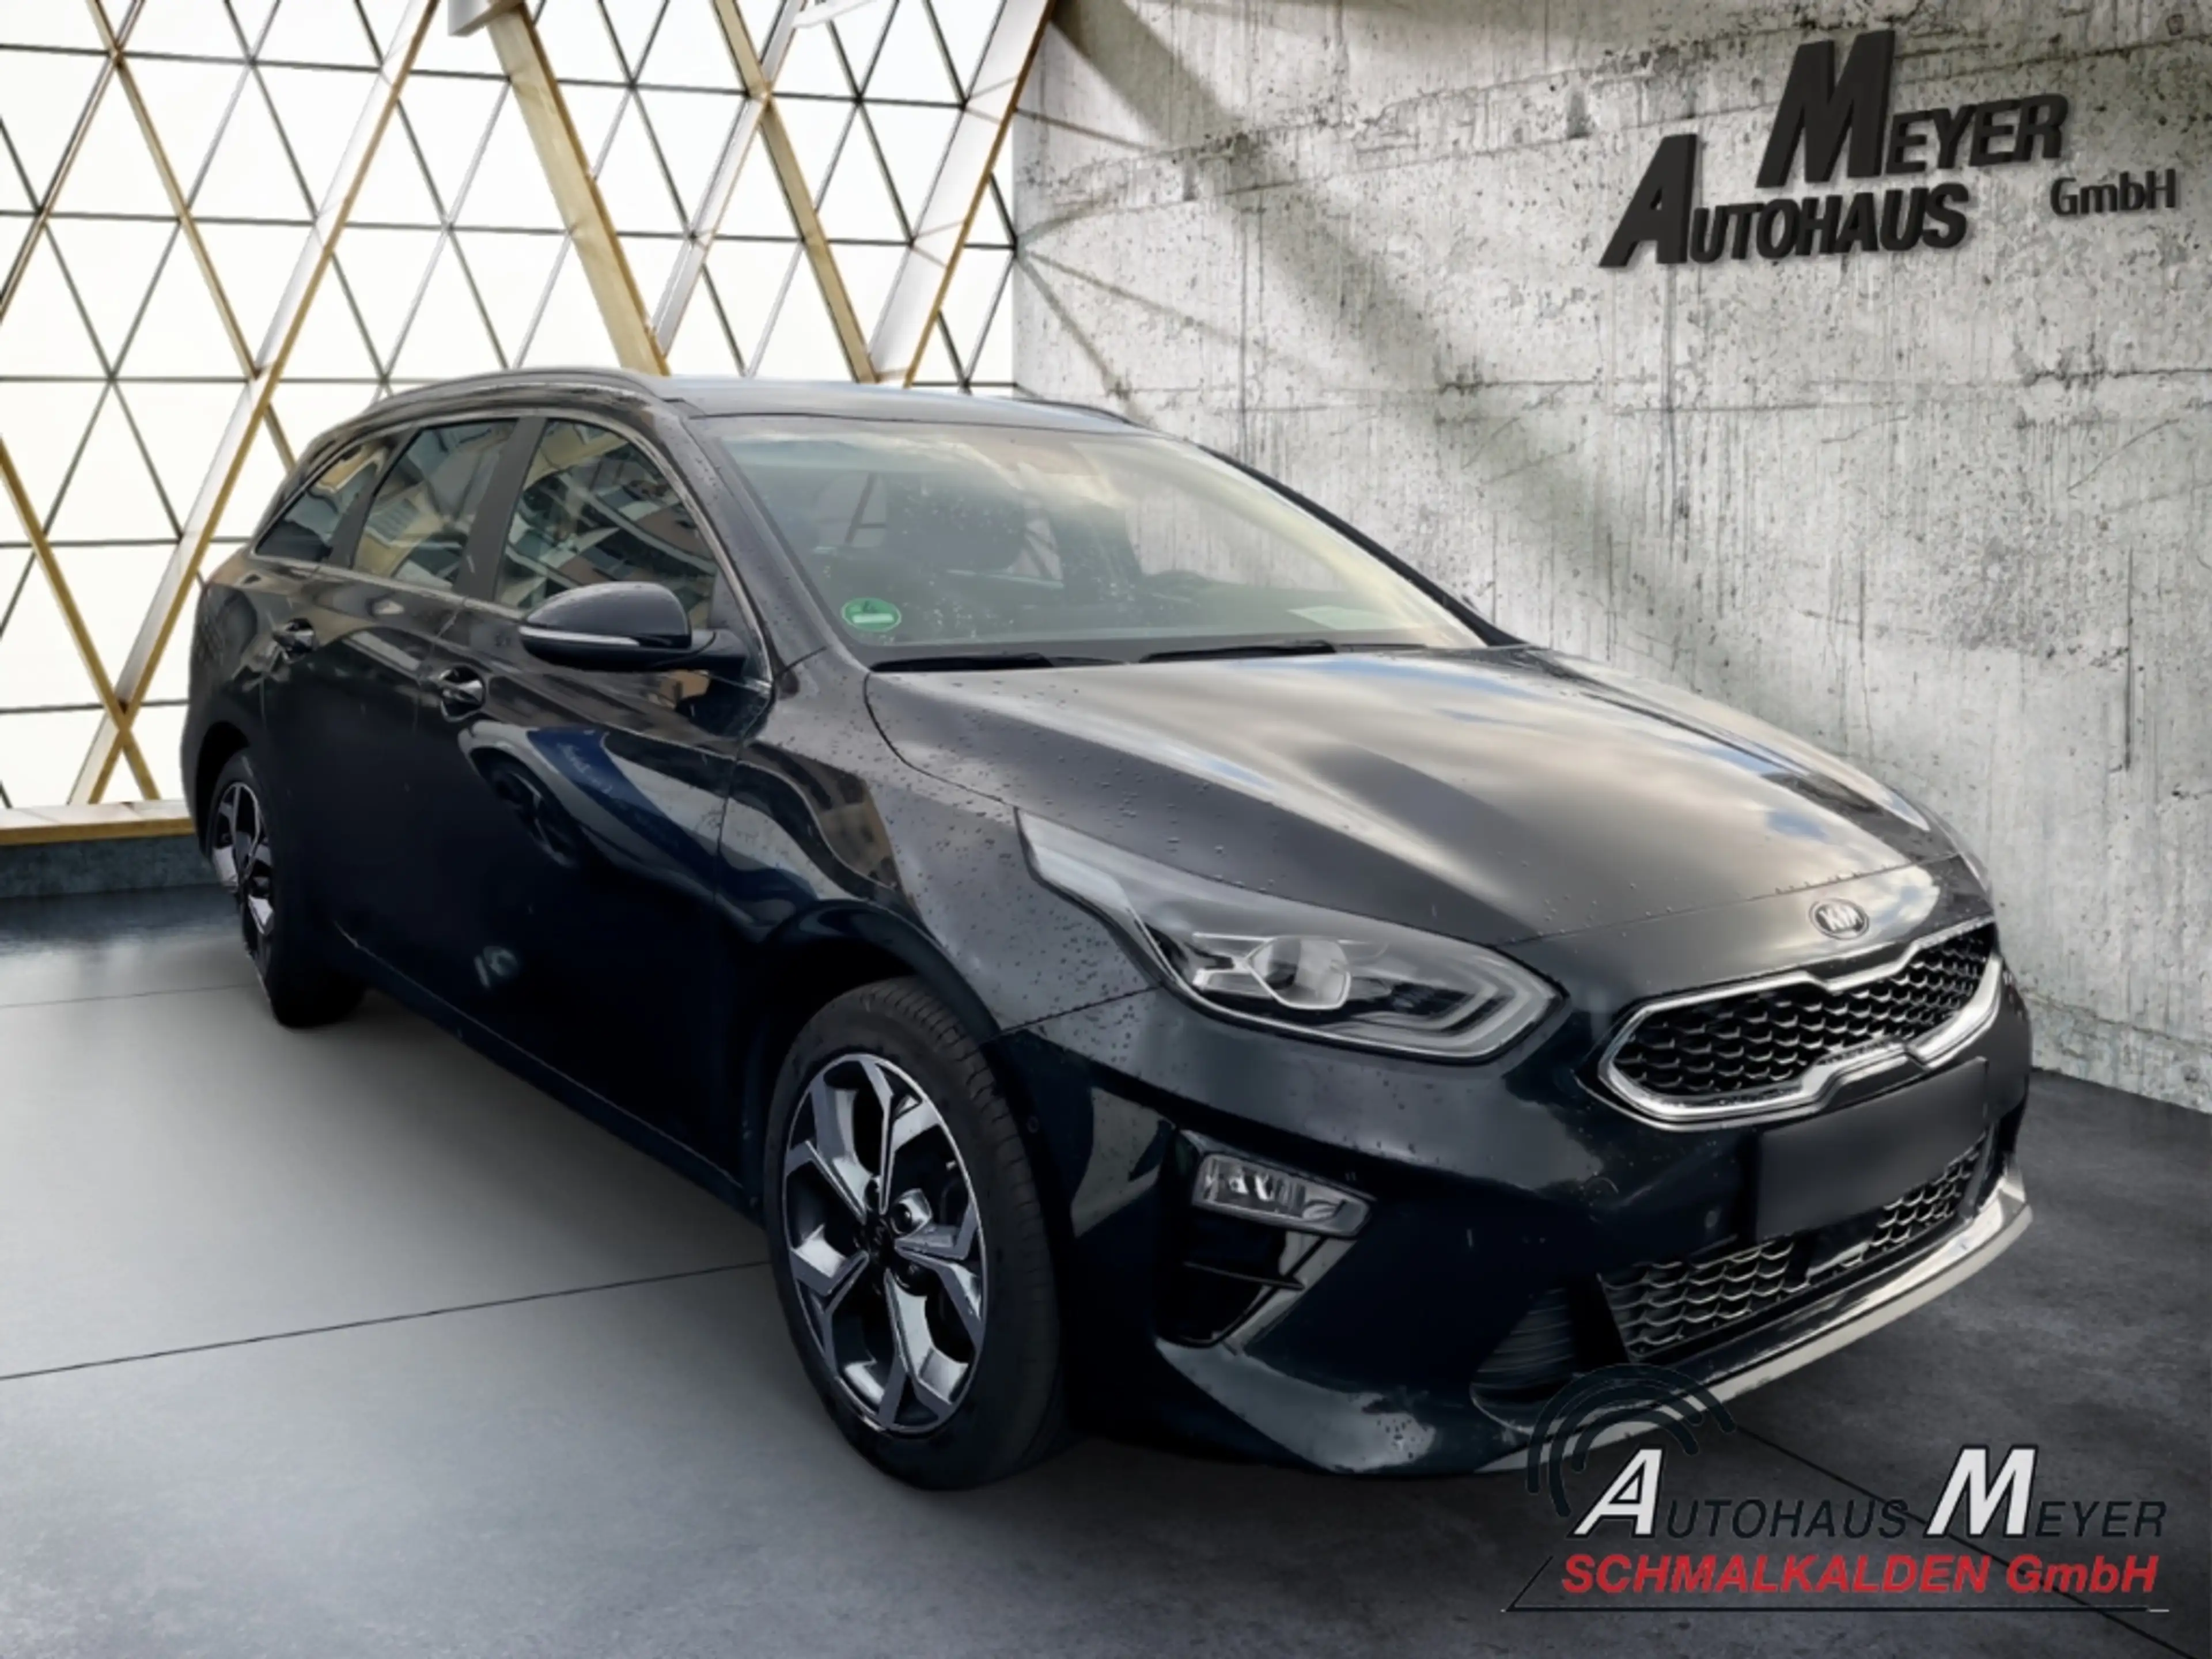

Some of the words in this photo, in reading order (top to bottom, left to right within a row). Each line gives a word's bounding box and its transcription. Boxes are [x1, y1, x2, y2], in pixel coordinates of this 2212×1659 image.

[1755, 29, 2069, 188] MEYER
[1599, 134, 1969, 268] AUTOHAUS
[2051, 169, 2176, 217] GmbH
[1819, 904, 1863, 931] KIA
